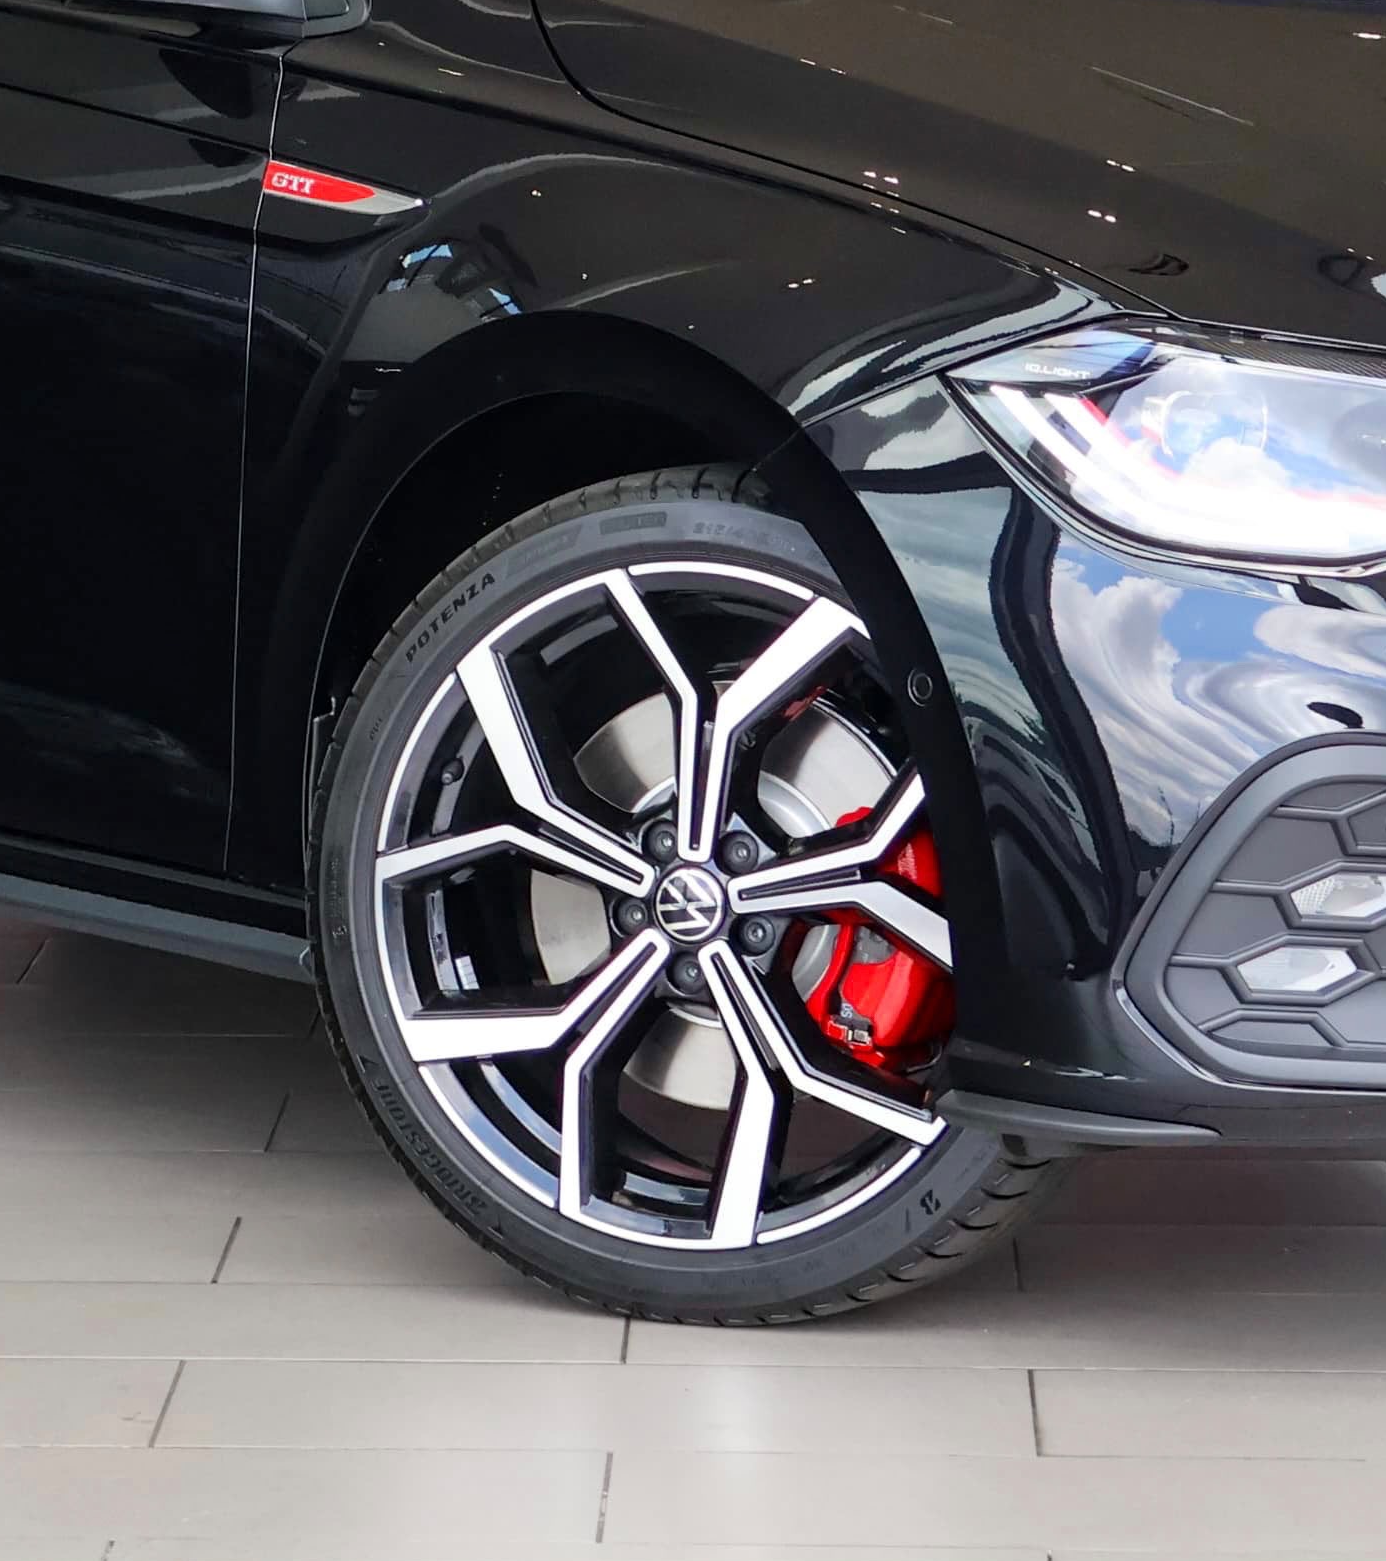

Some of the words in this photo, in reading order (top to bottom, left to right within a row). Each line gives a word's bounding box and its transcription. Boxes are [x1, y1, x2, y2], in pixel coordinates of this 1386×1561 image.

[271, 171, 313, 195] GTI
[1024, 362, 1091, 379] IQ.LIGHT
[404, 571, 497, 664] POTENZA
[371, 1077, 488, 1216] BRIDGESTONE
